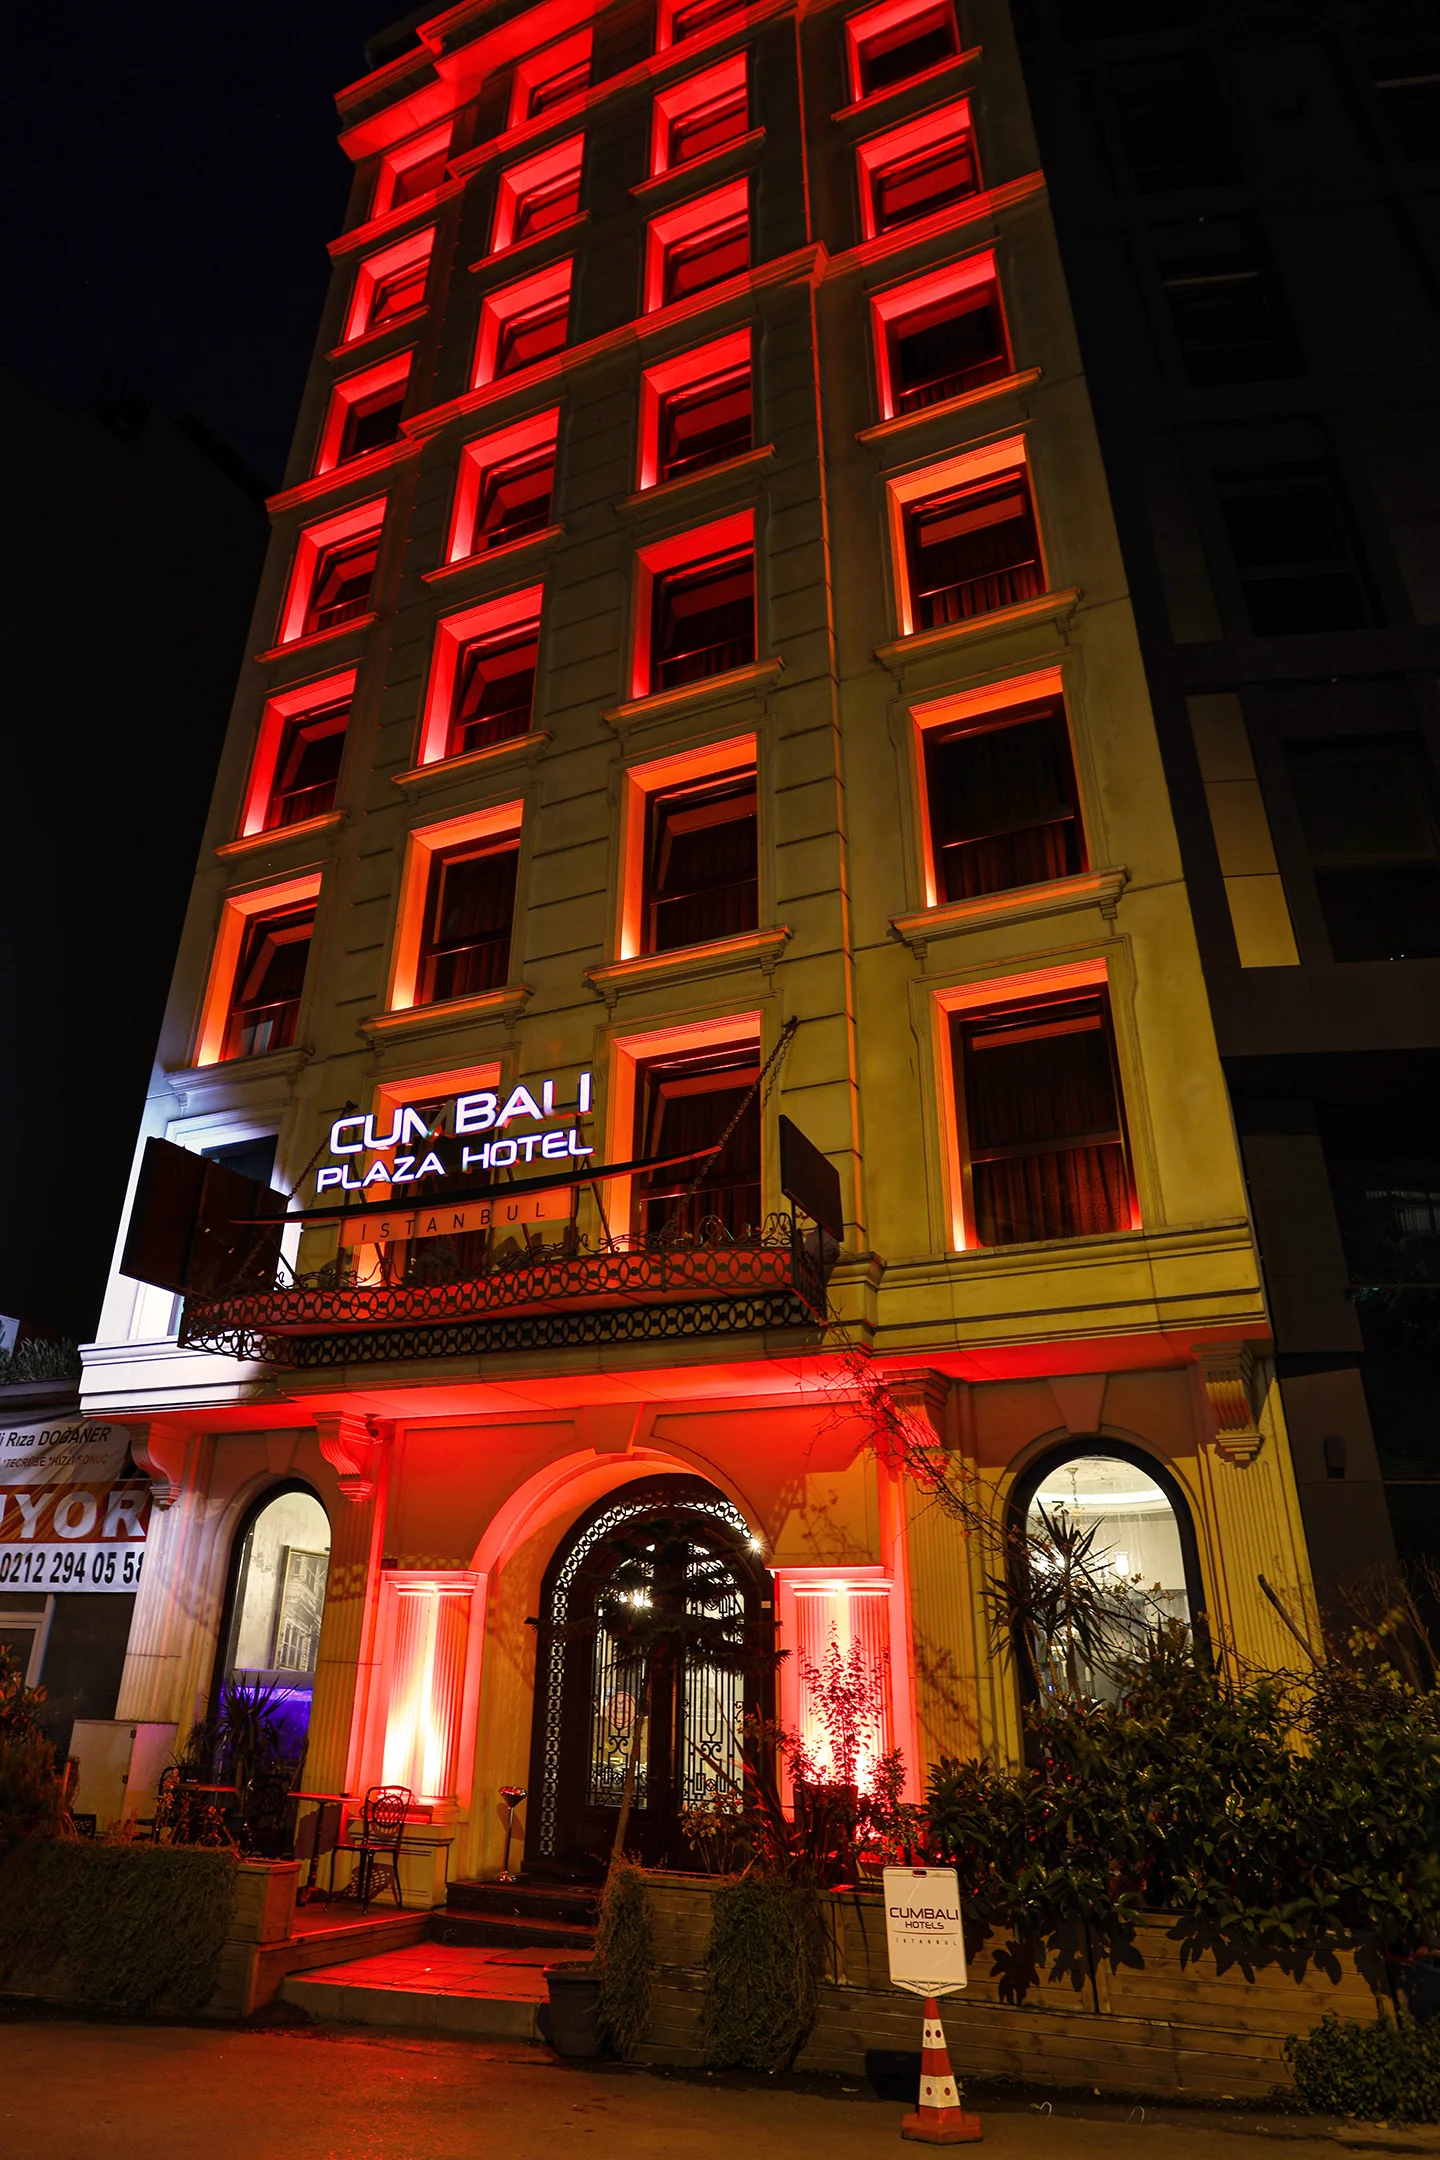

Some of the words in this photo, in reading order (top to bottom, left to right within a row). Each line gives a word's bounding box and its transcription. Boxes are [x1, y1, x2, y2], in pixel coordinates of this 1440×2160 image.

[316, 1151, 446, 1194] PLAZA
[462, 1128, 594, 1172] HOTEL
[361, 1201, 546, 1240] ISTANBUL
[38, 1426, 112, 1446] DOĞANER
[0, 1552, 46, 1583] 0212
[50, 1552, 86, 1583] 294
[92, 1552, 117, 1584] 05
[889, 1907, 959, 1920] CUMBALI
[905, 1921, 945, 1930] HOTELS
